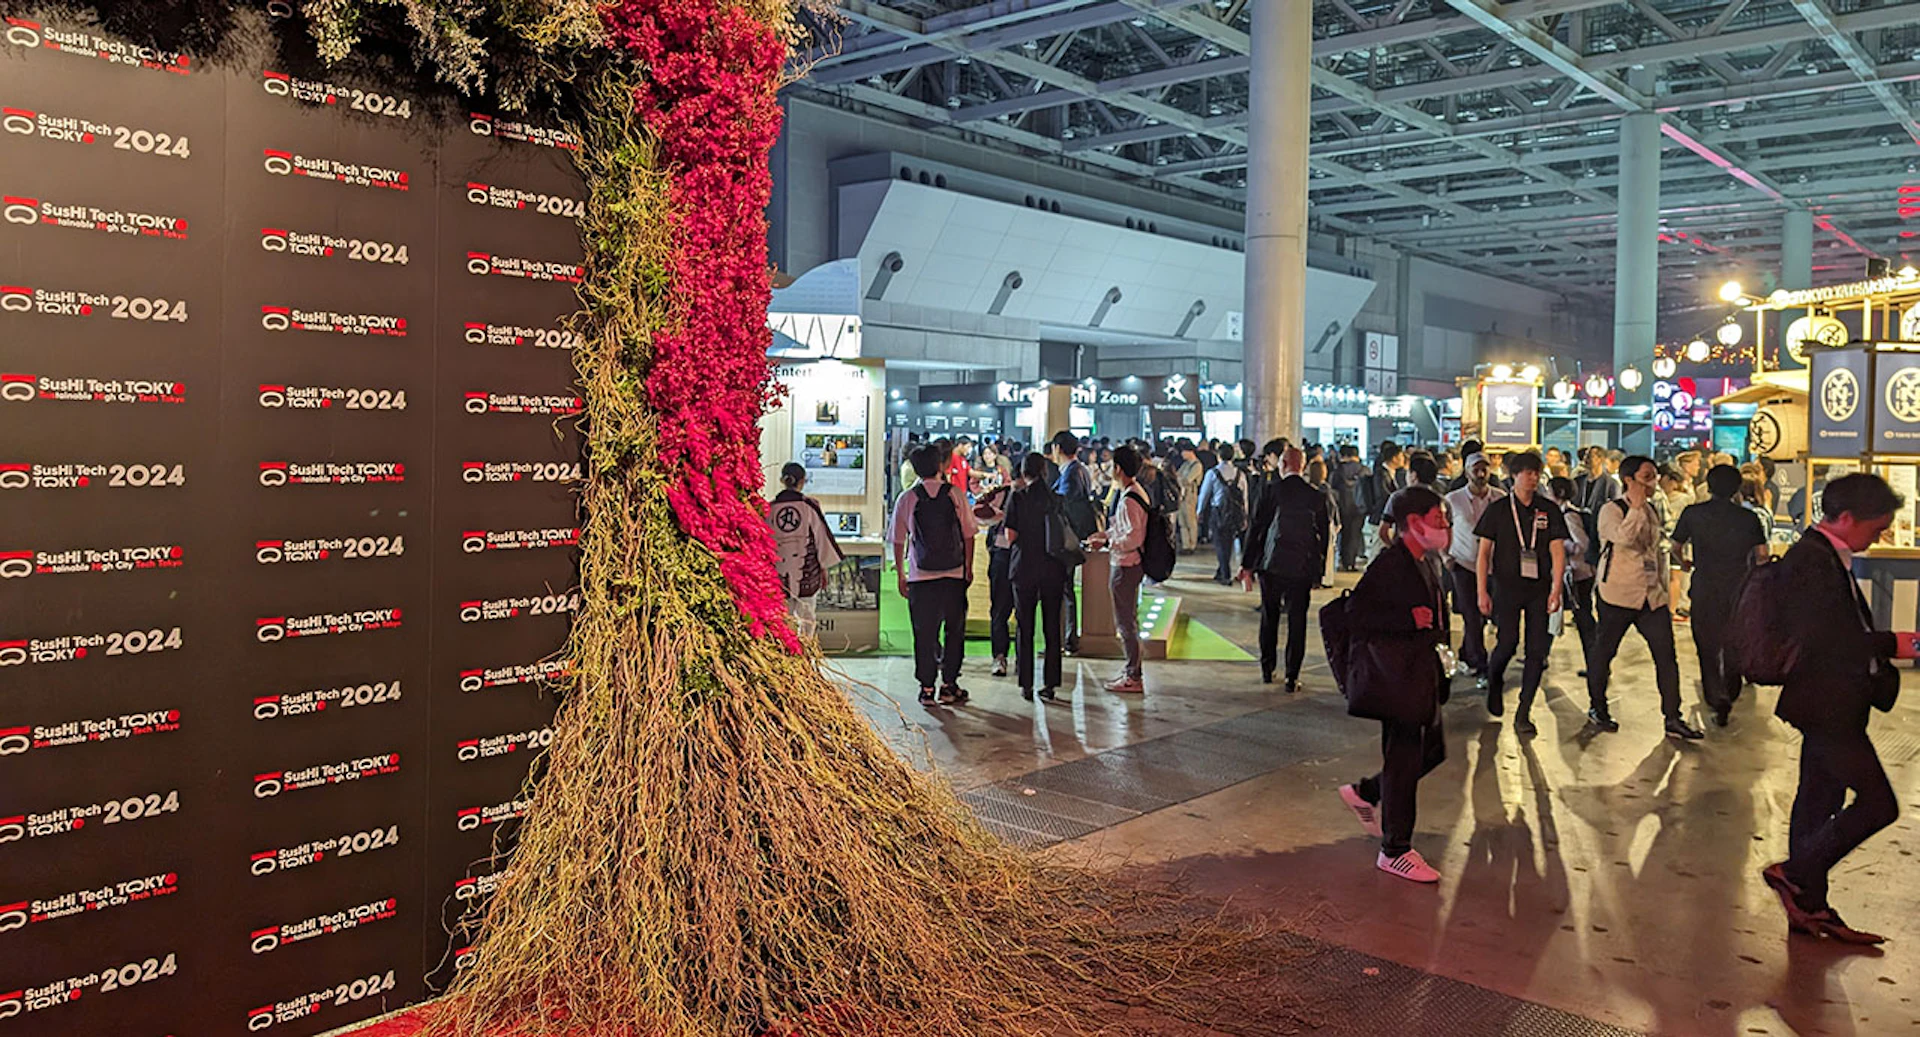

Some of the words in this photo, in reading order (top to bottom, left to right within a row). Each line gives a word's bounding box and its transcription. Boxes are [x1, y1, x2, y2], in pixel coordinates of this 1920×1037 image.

[44, 27, 88, 46] SusHi
[92, 37, 126, 55] Tech
[291, 78, 323, 94] SusHi
[325, 84, 350, 98] Tech
[351, 90, 411, 118] 2024
[38, 114, 78, 130] SusHi
[80, 120, 112, 136] Tech
[38, 125, 95, 144] TOKYO
[114, 127, 189, 158] 2024
[294, 156, 329, 171] SusHi
[331, 161, 360, 178] Tech
[361, 166, 409, 184] TOKYO
[489, 186, 515, 199] SusHi
[516, 190, 536, 202] Tech
[537, 195, 585, 219] 2024
[41, 216, 95, 229] Sustainable
[96, 222, 119, 233] High
[120, 224, 139, 235] City
[42, 203, 86, 219] SusHi
[89, 208, 125, 226] Tech
[127, 213, 188, 231] TOKYO
[289, 232, 321, 245] SusHi
[322, 236, 347, 249] Tech
[289, 243, 334, 257] TOKYO
[349, 240, 408, 264] 2024
[491, 256, 520, 269] SusHi
[521, 260, 545, 274] Tech
[35, 289, 75, 303] SusHi
[78, 292, 109, 306] Tech
[36, 301, 93, 316] TOKYO
[112, 296, 187, 322] 2024
[292, 310, 327, 323] SusHi
[329, 313, 358, 327] Tech
[358, 315, 407, 329] TOKYO
[487, 325, 513, 337] SusHi
[514, 327, 535, 338] Tech
[39, 378, 84, 392] SusHi
[87, 379, 123, 394] Tech
[125, 381, 185, 396] TOKYO
[286, 387, 318, 398] SusHi
[319, 388, 345, 399] Tech
[38, 391, 92, 400] Sustainable
[94, 392, 117, 402] High
[118, 393, 136, 403] City
[287, 397, 332, 408] TOKYO
[346, 389, 406, 409] 2024
[489, 394, 518, 406] SusHi
[519, 395, 543, 408] Tech
[1100, 391, 1138, 404] Zone
[33, 465, 73, 476] SusHi
[75, 464, 107, 476] Tech
[109, 464, 185, 486] 2024
[289, 464, 325, 476] SusHi
[326, 464, 356, 476] Tech
[356, 463, 405, 476] TOKYO
[485, 463, 511, 473] SusHi
[511, 463, 532, 473] Tech
[533, 463, 582, 482] 2024
[33, 476, 90, 488] TOKYO
[284, 540, 316, 552] SusHi
[317, 539, 343, 551] Tech
[487, 531, 515, 543] SusHi
[517, 530, 541, 541] Tech
[37, 551, 81, 566] SusHi
[84, 549, 120, 564] Tech
[122, 546, 183, 562] TOKYO
[284, 550, 329, 561] TOKYO
[344, 536, 404, 558] 2024
[36, 564, 90, 573] Sustainable
[91, 562, 114, 572] High
[115, 561, 134, 570] City
[482, 599, 508, 611] SusHi
[509, 598, 530, 608] Tech
[530, 594, 580, 615] 2024
[287, 615, 322, 630] SusHi
[324, 613, 353, 626] Tech
[354, 608, 402, 624] TOKYO
[30, 637, 70, 651] SusHi
[72, 634, 104, 647] Tech
[106, 628, 182, 655] 2024
[30, 648, 87, 663] TOKYO
[484, 667, 513, 681] SusHi
[514, 664, 537, 677] Tech
[281, 692, 313, 705] SusHi
[314, 689, 340, 702] Tech
[341, 681, 401, 707] 2024
[281, 700, 326, 715] TOKYO
[34, 722, 78, 740] SusHi
[81, 718, 118, 734] Tech
[119, 710, 180, 730] TOKYO
[33, 735, 87, 748] Sustainable
[88, 731, 111, 741] High
[112, 729, 131, 738] City
[480, 736, 505, 749] SusHi
[506, 733, 527, 744] Tech
[284, 767, 319, 784] SusHi
[321, 762, 350, 777] Tech
[351, 753, 399, 771] TOKYO
[28, 809, 67, 826] SusHi
[70, 804, 102, 819] Tech
[104, 791, 179, 824] 2024
[28, 818, 85, 837] TOKYO
[278, 844, 310, 859] SusHi
[311, 839, 337, 852] Tech
[338, 826, 398, 856] 2024
[279, 852, 323, 869] TOKYO
[31, 893, 76, 915] SusHi
[79, 887, 115, 903] Tech
[117, 873, 177, 895] TOKYO
[281, 918, 316, 938] SusHi
[318, 912, 347, 927] Tech
[348, 898, 396, 919] TOKYO
[101, 954, 176, 992] 2024
[25, 981, 65, 1000] SusHi
[67, 973, 99, 990] Tech
[335, 971, 395, 1005] 2024
[25, 988, 82, 1011] TOKYO
[275, 996, 307, 1013] SusHi
[308, 989, 334, 1004] Tech
[276, 1003, 320, 1023] TOKYO
